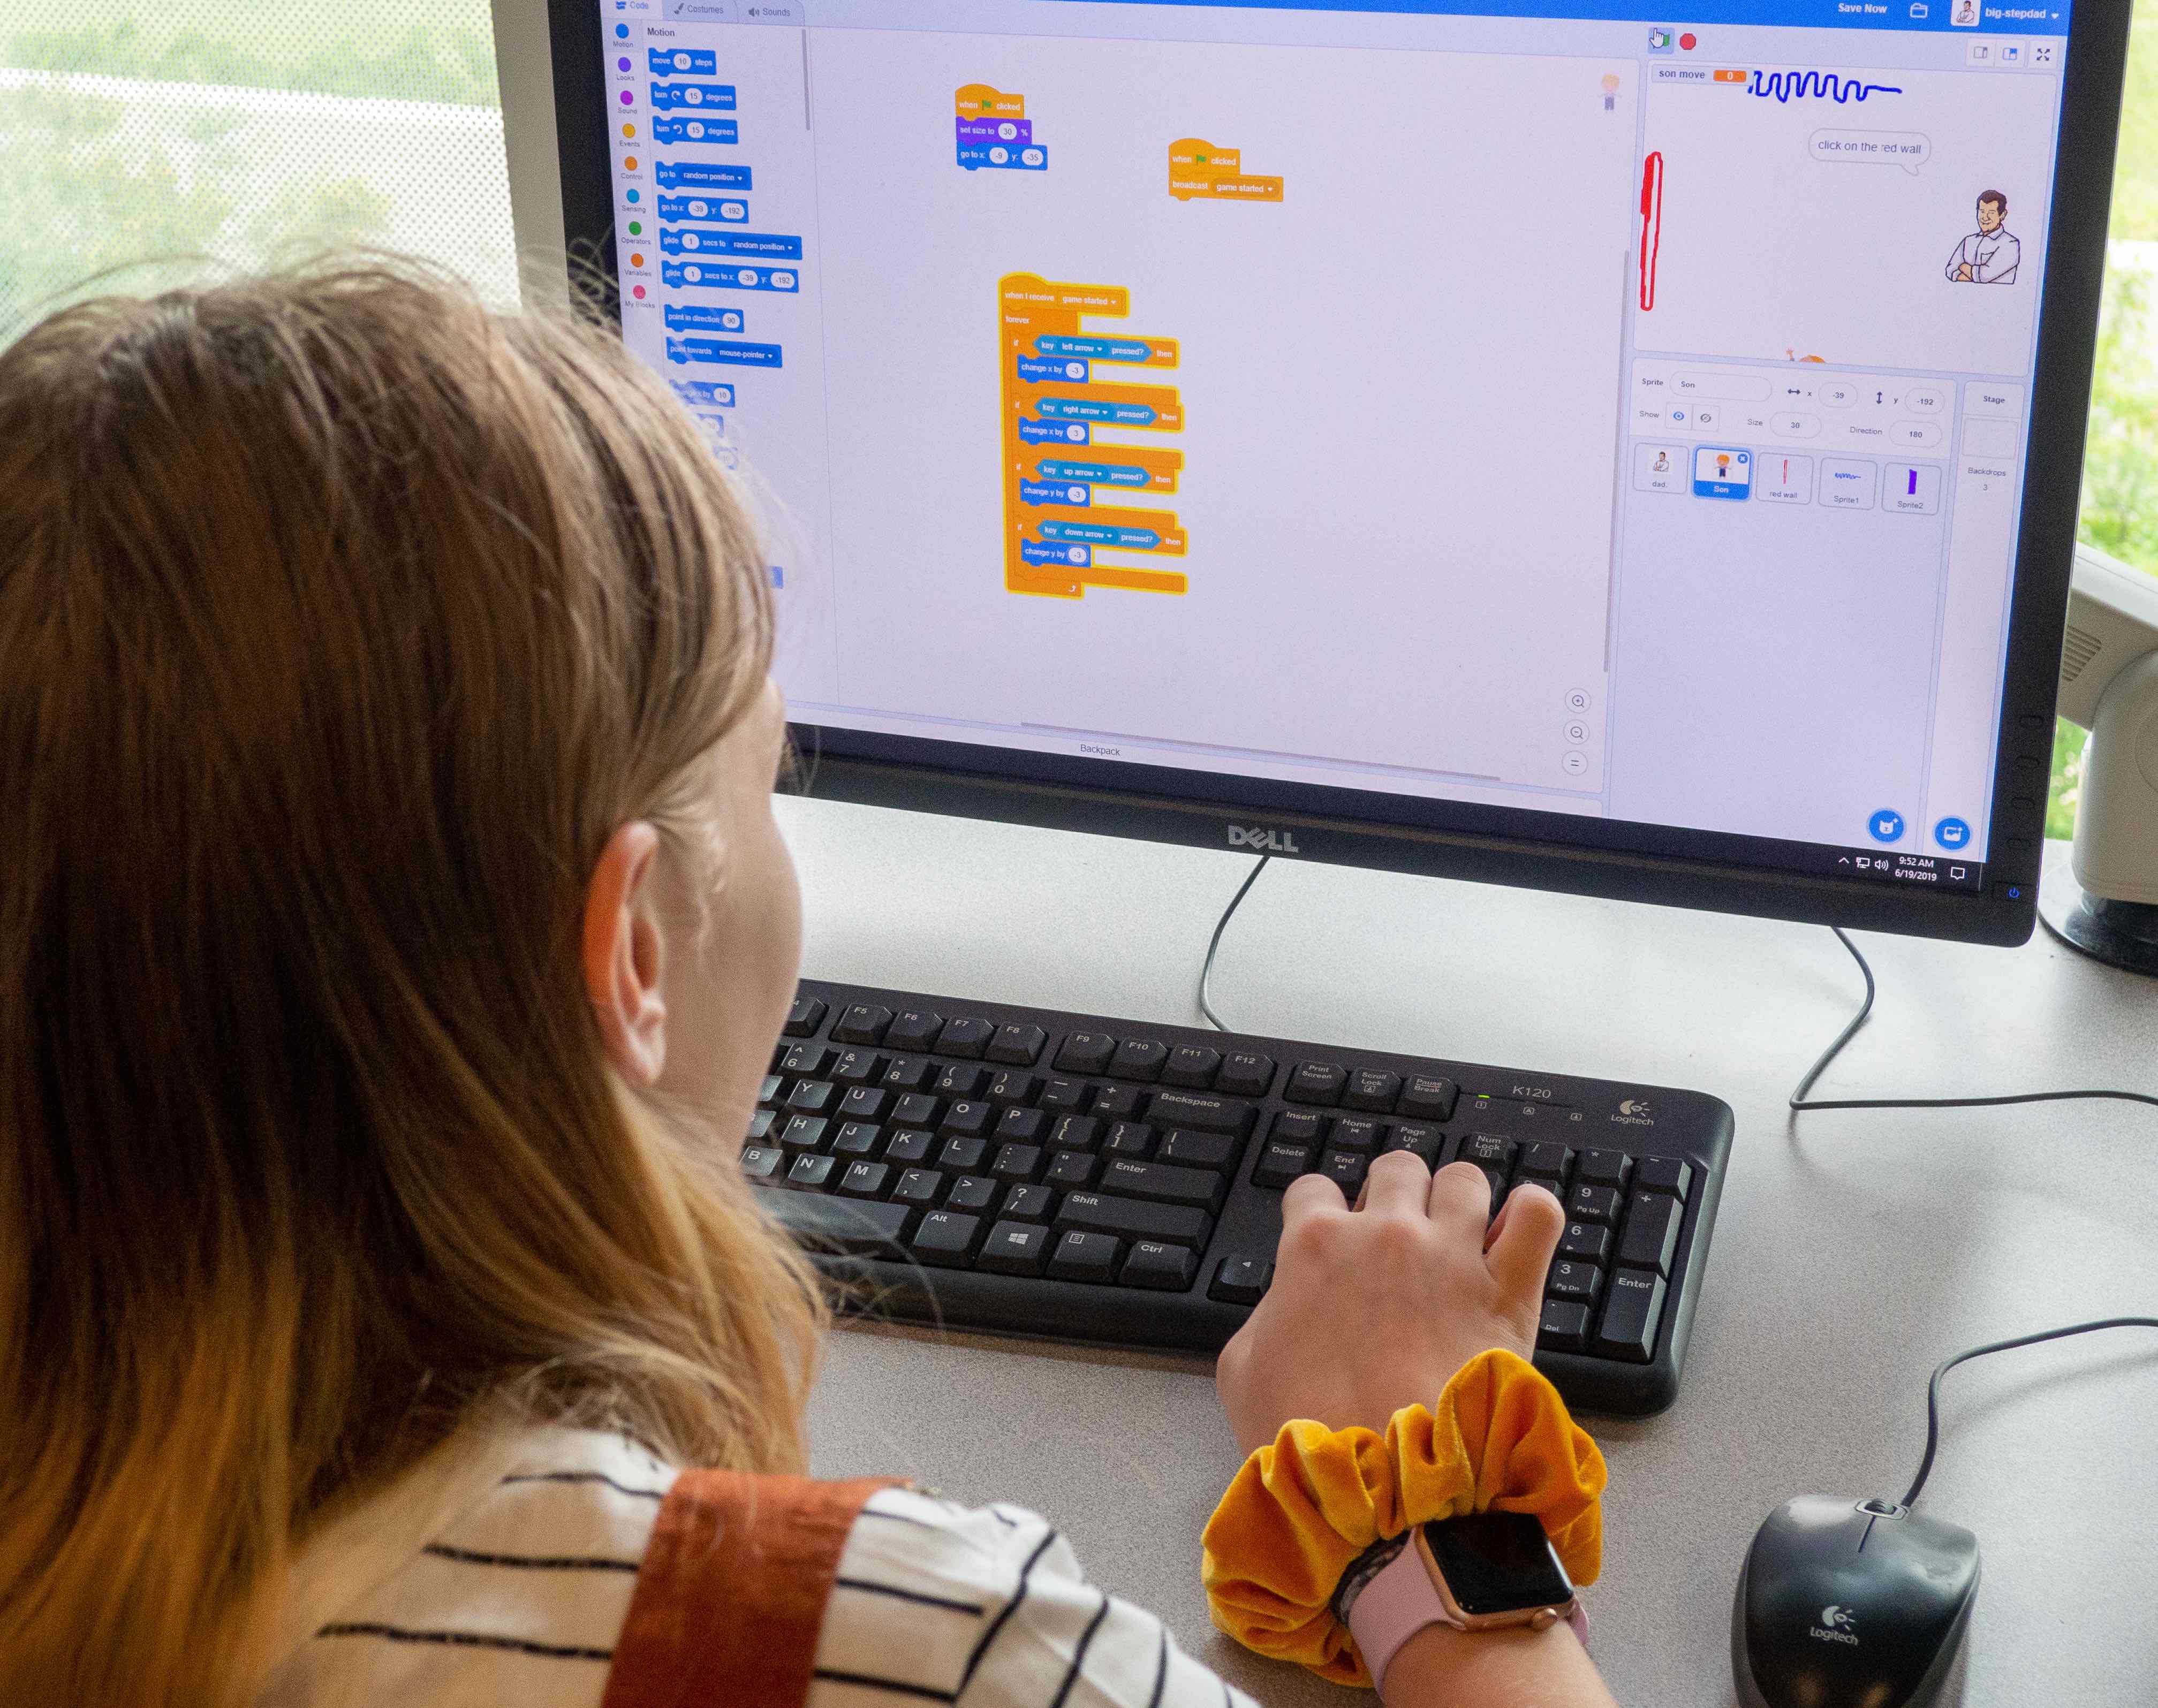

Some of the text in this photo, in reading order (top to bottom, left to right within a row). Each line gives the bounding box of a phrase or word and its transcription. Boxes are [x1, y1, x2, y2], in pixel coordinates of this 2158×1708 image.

[687, 5, 723, 14] Costumes
[763, 8, 791, 17] Sounds
[1838, 3, 1887, 14] Save Now
[1985, 7, 2046, 20] big-stepdad
[647, 28, 675, 37] Motion
[1660, 70, 1733, 80] son move 0
[997, 103, 1020, 111] clicked
[708, 128, 734, 136] degrees
[1818, 140, 1921, 154] click on the red wall
[684, 172, 734, 181] random position
[1172, 180, 1264, 193] broadcast game started
[622, 205, 646, 214] Sensing
[621, 238, 651, 246] Operators
[734, 241, 785, 251] random position
[775, 276, 790, 284] -192
[1062, 296, 1082, 304] game
[1005, 316, 1029, 324] forever
[1041, 342, 1054, 350] key
[1062, 343, 1073, 351] left
[1111, 347, 1144, 355] pressed?
[720, 348, 765, 359] mouse-pointer
[1021, 363, 1046, 373] change
[1642, 378, 1663, 386] Sprite
[1983, 396, 2005, 404] Stage
[1043, 405, 1055, 413] key
[1063, 406, 1078, 415] right
[1117, 411, 1149, 419] pressed?
[1747, 419, 1763, 427] Size
[1023, 427, 1047, 436] change
[1850, 427, 1882, 435] Direction
[1043, 466, 1056, 475] key
[1064, 468, 1073, 476] up
[1111, 472, 1144, 481] pressed?
[1156, 475, 1171, 483] then
[1968, 467, 2006, 477] Backdrops
[1024, 487, 1048, 497] change
[1769, 490, 1782, 498] red
[1834, 496, 1859, 504] Sprite1
[1897, 501, 1923, 509] Sprite2
[1045, 527, 1180, 545] key down arrow pressed? then
[1025, 548, 1049, 557] change
[1080, 744, 1120, 756] Backpack
[1228, 825, 1298, 853] DELL
[1899, 856, 1934, 868] 9:52 AM
[1895, 869, 1937, 881] 6/19/2019
[904, 1013, 918, 1021] F6
[1006, 1026, 1020, 1034] F8
[1129, 1042, 1149, 1051] F10
[1182, 1049, 1201, 1057] F11
[787, 1058, 798, 1067] 6
[1235, 1056, 1256, 1064] F12
[839, 1065, 850, 1073] 7
[1308, 1065, 1329, 1073] Print
[890, 1071, 900, 1080] 8
[1302, 1071, 1332, 1080] Screen
[1361, 1072, 1386, 1080] Scroll
[942, 1078, 953, 1087] 9
[1361, 1078, 1382, 1087] Lock
[1416, 1079, 1442, 1087] Pause
[802, 1083, 813, 1092] Y
[1512, 1085, 1551, 1098] K120
[853, 1090, 865, 1099] U
[1161, 1092, 1221, 1108] Backspace
[1009, 1110, 1021, 1119] P
[1286, 1111, 1316, 1121] Insert
[793, 1119, 807, 1129] H
[1343, 1118, 1372, 1129] Home
[1611, 1114, 1654, 1126] Logitech
[846, 1127, 857, 1136] J
[1400, 1127, 1426, 1136] Page
[898, 1134, 912, 1144] K
[1403, 1135, 1418, 1144] Up
[1477, 1135, 1501, 1144] Num
[951, 1140, 961, 1150] L
[1475, 1142, 1500, 1151] Lock
[747, 1150, 761, 1160] B
[1272, 1146, 1305, 1158] Delete
[800, 1158, 815, 1169] N
[1334, 1156, 1355, 1166] End
[853, 1165, 869, 1176] M
[1116, 1163, 1146, 1174] Enter
[1581, 1188, 1592, 1197] 9
[1072, 1195, 1099, 1206] Shift
[931, 1214, 948, 1223] Alt
[1571, 1225, 1581, 1235] 6
[1141, 1244, 1162, 1254] Ctrl
[1560, 1264, 1571, 1274] 3
[1618, 1278, 1652, 1289] Enter
[1546, 1324, 1559, 1332] Del
[1810, 1627, 1859, 1645] Logitech
